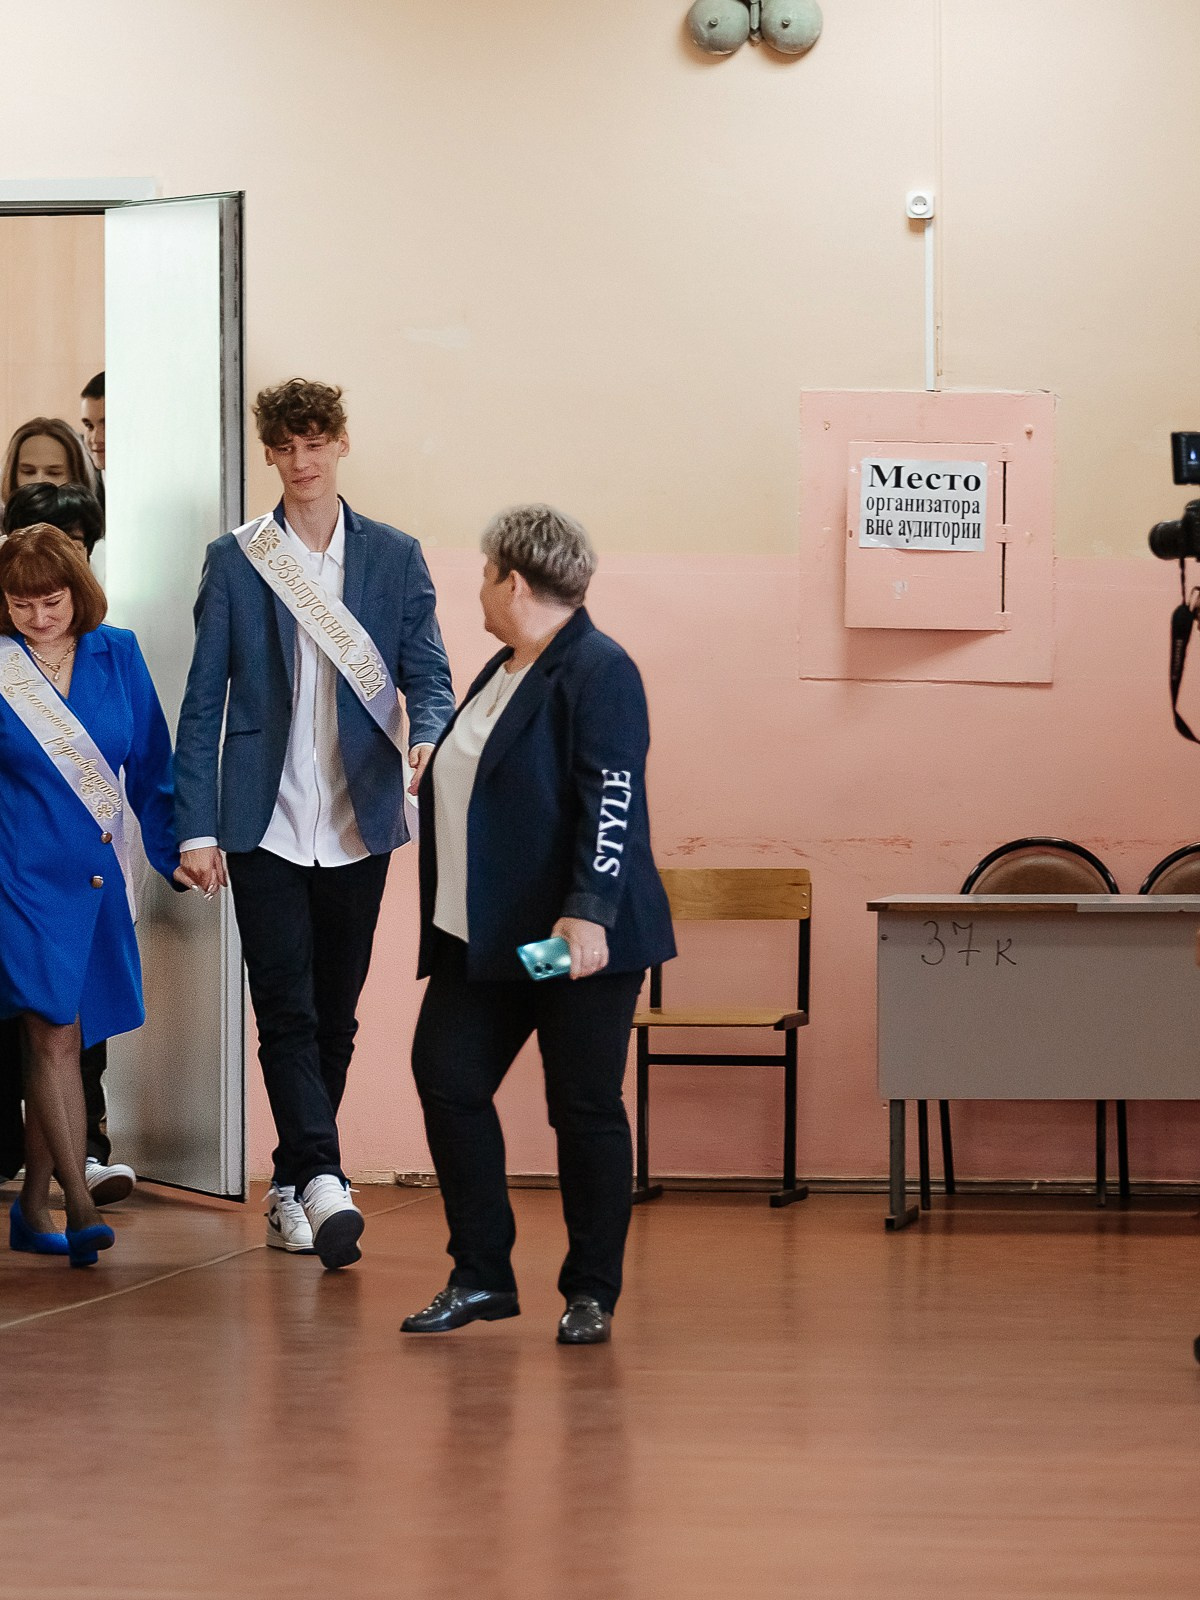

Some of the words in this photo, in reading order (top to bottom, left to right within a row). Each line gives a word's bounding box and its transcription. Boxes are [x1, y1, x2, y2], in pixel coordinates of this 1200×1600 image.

[868, 464, 981, 492] Место
[866, 496, 980, 519] организатора
[866, 518, 893, 536] вне
[898, 519, 981, 545] аудитории
[349, 655, 386, 697] 2024
[593, 769, 632, 877] STYLE
